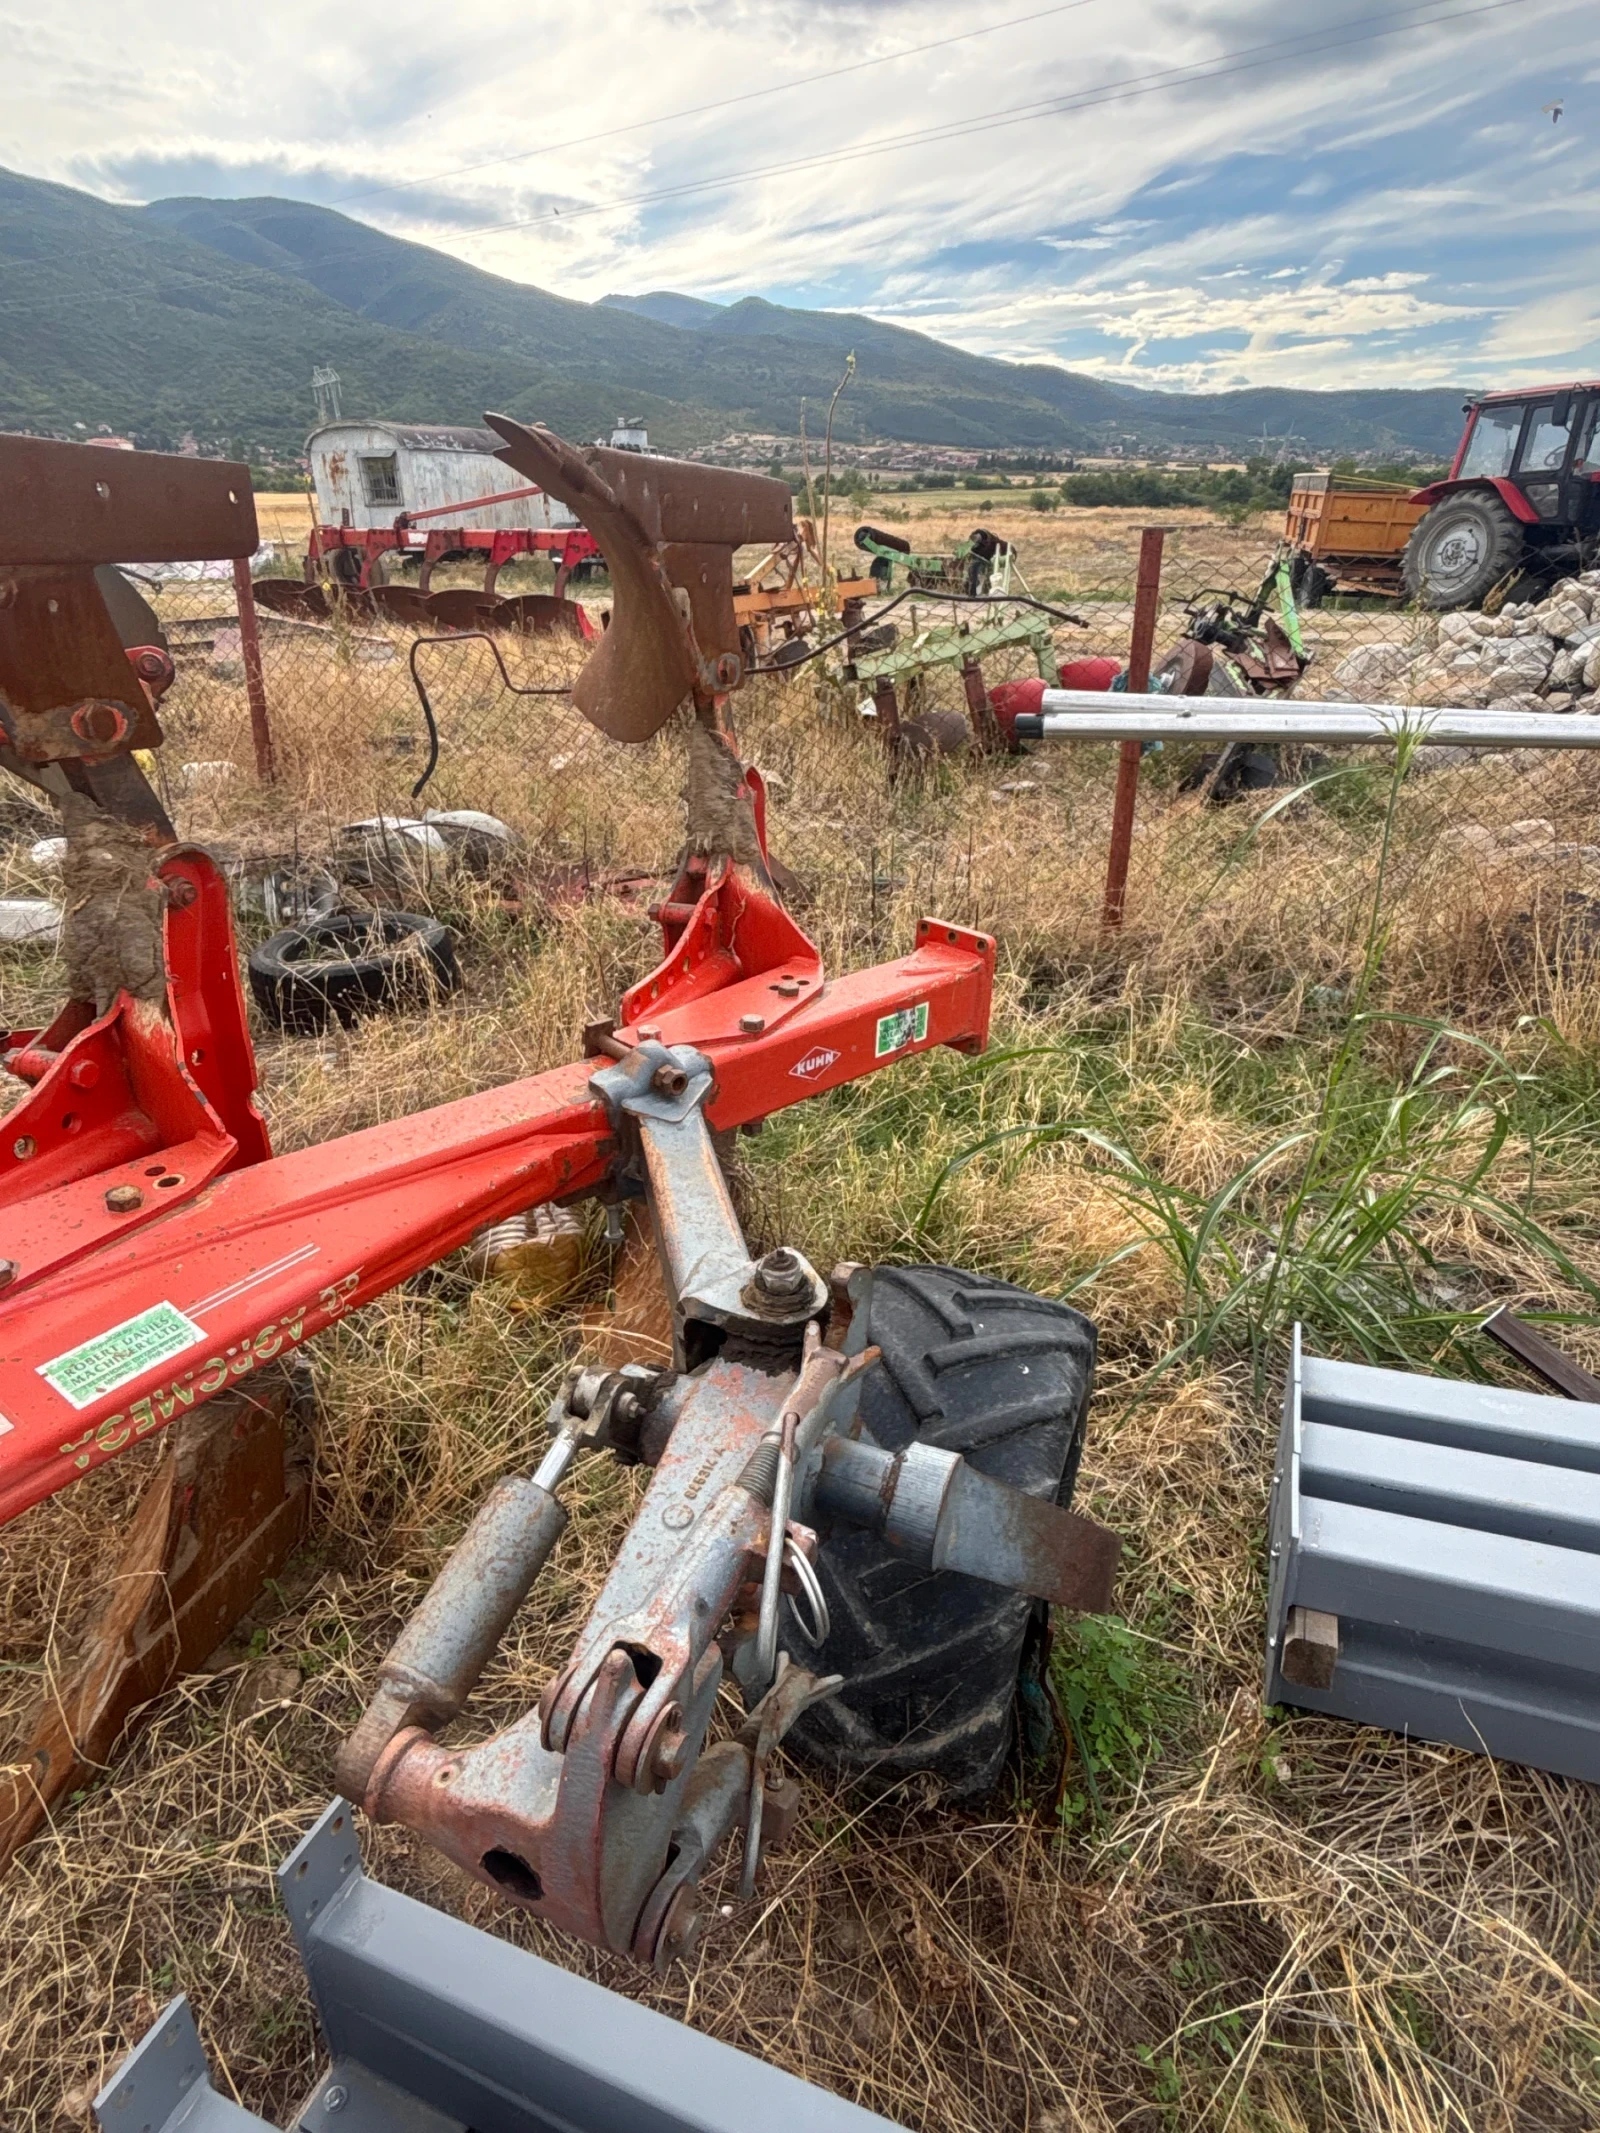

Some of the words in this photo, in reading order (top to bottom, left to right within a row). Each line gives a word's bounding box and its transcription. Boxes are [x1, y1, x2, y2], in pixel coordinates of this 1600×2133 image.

[796, 1052, 834, 1075] KUHN
[64, 1344, 119, 1376] ROBERT
[123, 1317, 170, 1345] DAVIES
[154, 1323, 180, 1339] LTD
[60, 1307, 305, 1468] AGROMEGA
